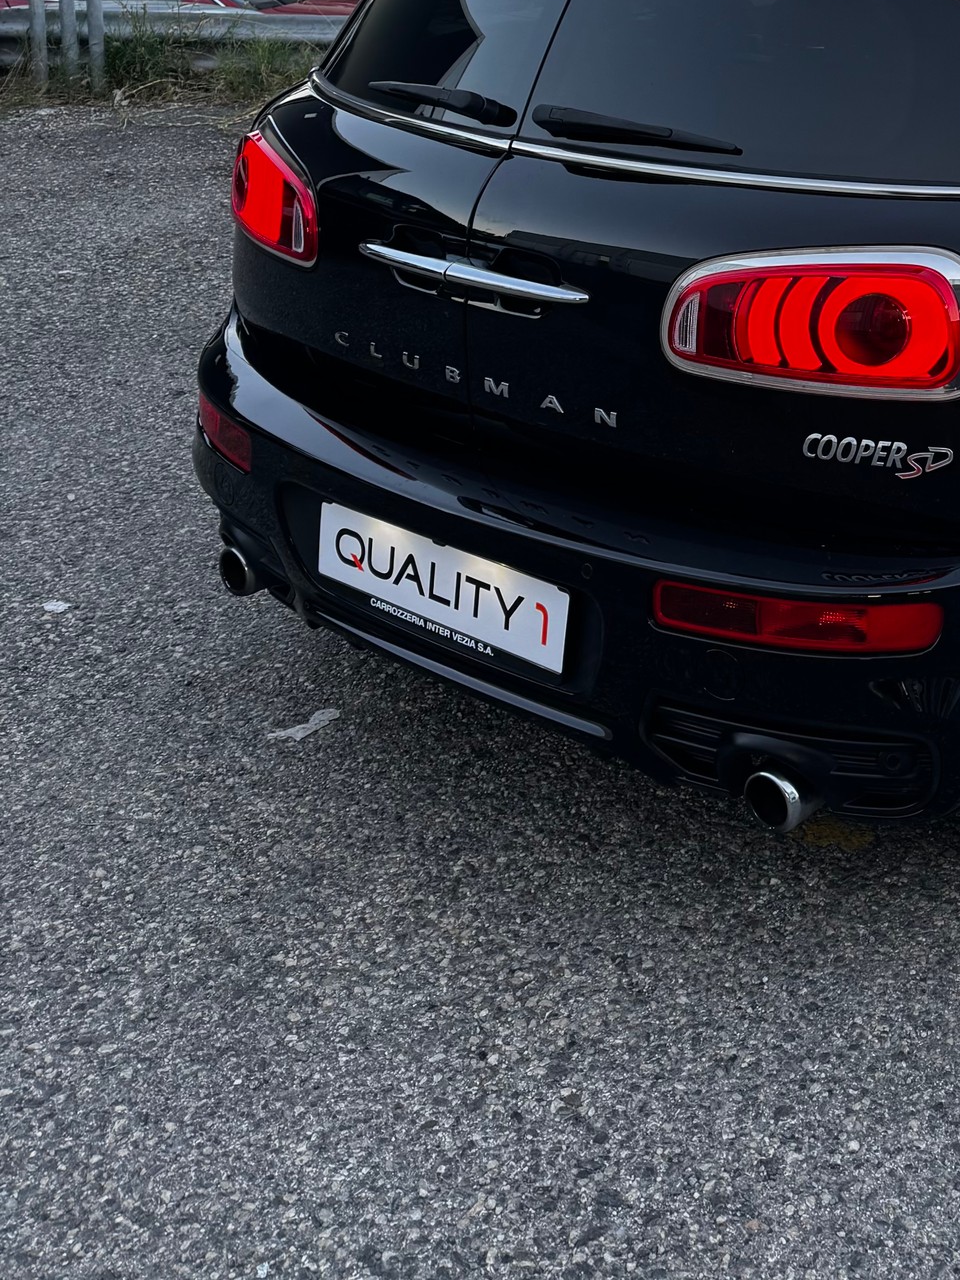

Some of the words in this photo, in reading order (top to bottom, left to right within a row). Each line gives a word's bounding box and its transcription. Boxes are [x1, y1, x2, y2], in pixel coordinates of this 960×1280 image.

[334, 331, 618, 428] CLUBMAN
[802, 433, 907, 469] COOPER
[335, 528, 525, 631] QUALITY
[535, 602, 549, 646] 1
[370, 598, 425, 628] CARROZZERIA
[426, 621, 451, 639] INTER
[452, 631, 476, 649] VEZIA
[477, 643, 494, 656] S.A.
